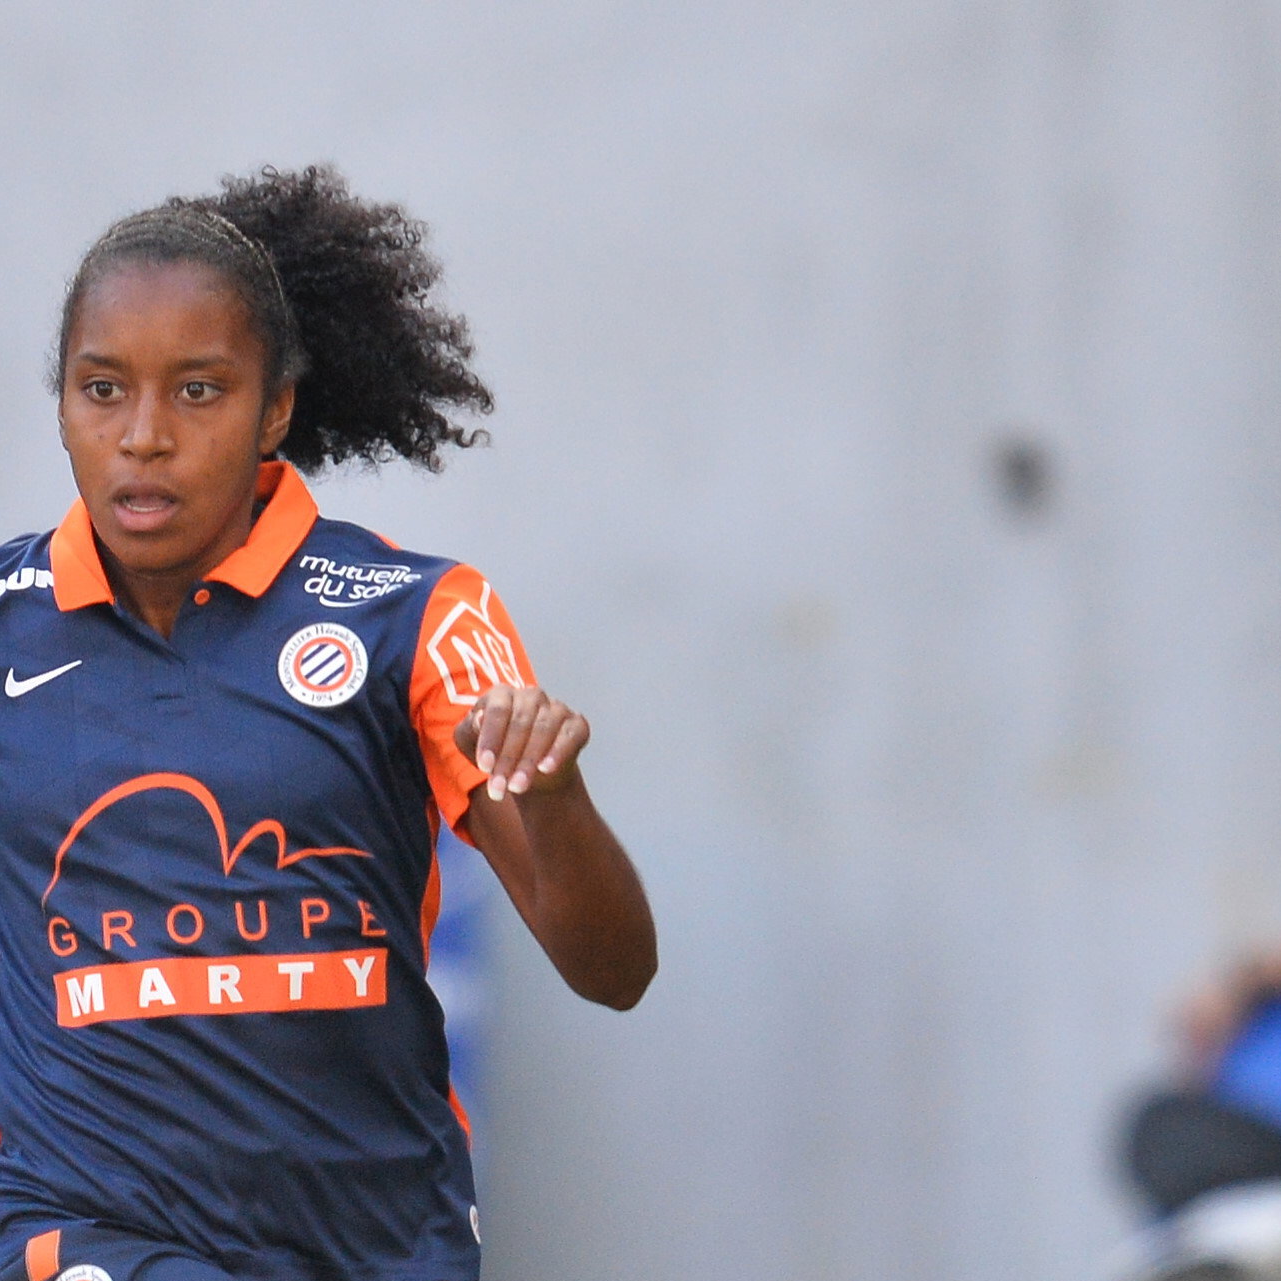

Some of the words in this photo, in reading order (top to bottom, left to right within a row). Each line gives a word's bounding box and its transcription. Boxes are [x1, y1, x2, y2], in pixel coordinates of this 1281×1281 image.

[304, 573, 345, 596] du
[47, 897, 387, 957] GROUPE
[66, 955, 376, 1018] MARTY
